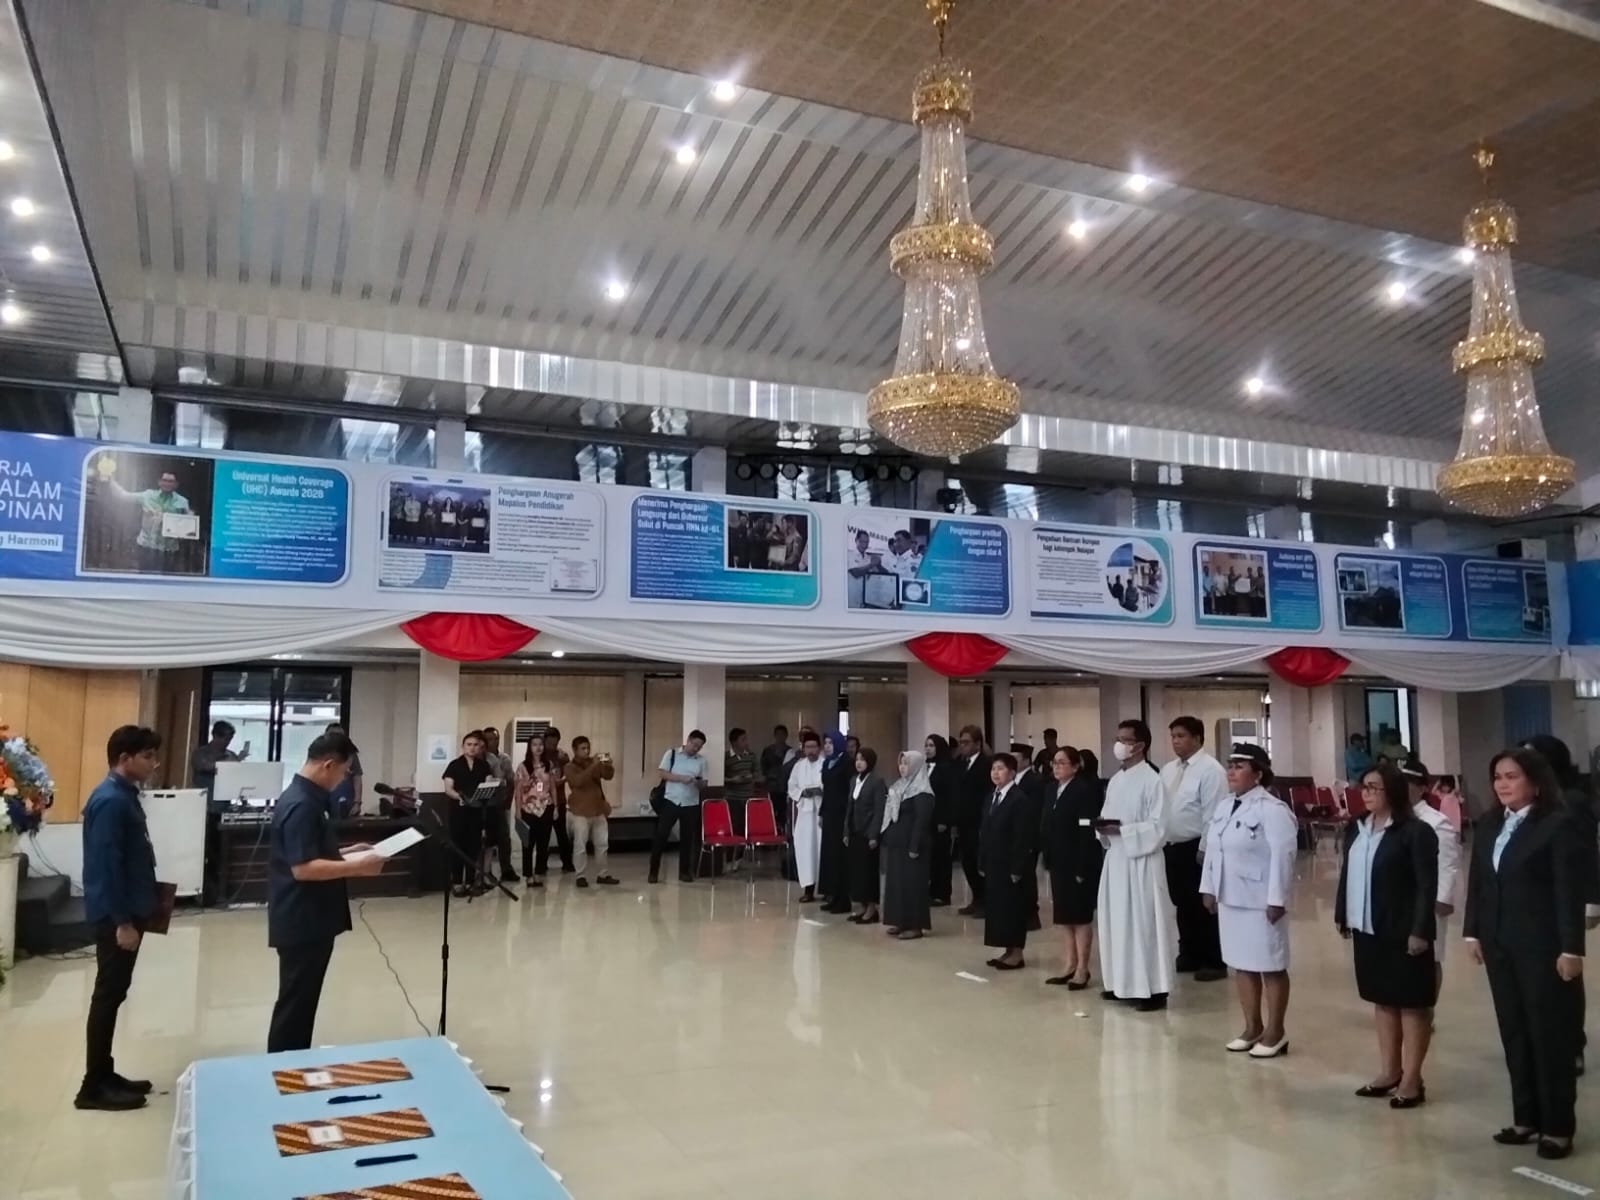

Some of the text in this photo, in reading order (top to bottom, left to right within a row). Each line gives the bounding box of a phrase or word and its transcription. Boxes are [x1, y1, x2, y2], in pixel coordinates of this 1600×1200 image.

[0, 460, 33, 477] RJA
[232, 470, 334, 488] Universal Health Coverage
[0, 479, 61, 500] ALAM
[242, 482, 268, 496] (UHC)
[270, 486, 299, 497] Awards
[528, 500, 564, 511] Pendidikan
[8, 533, 59, 547] Harmoni
